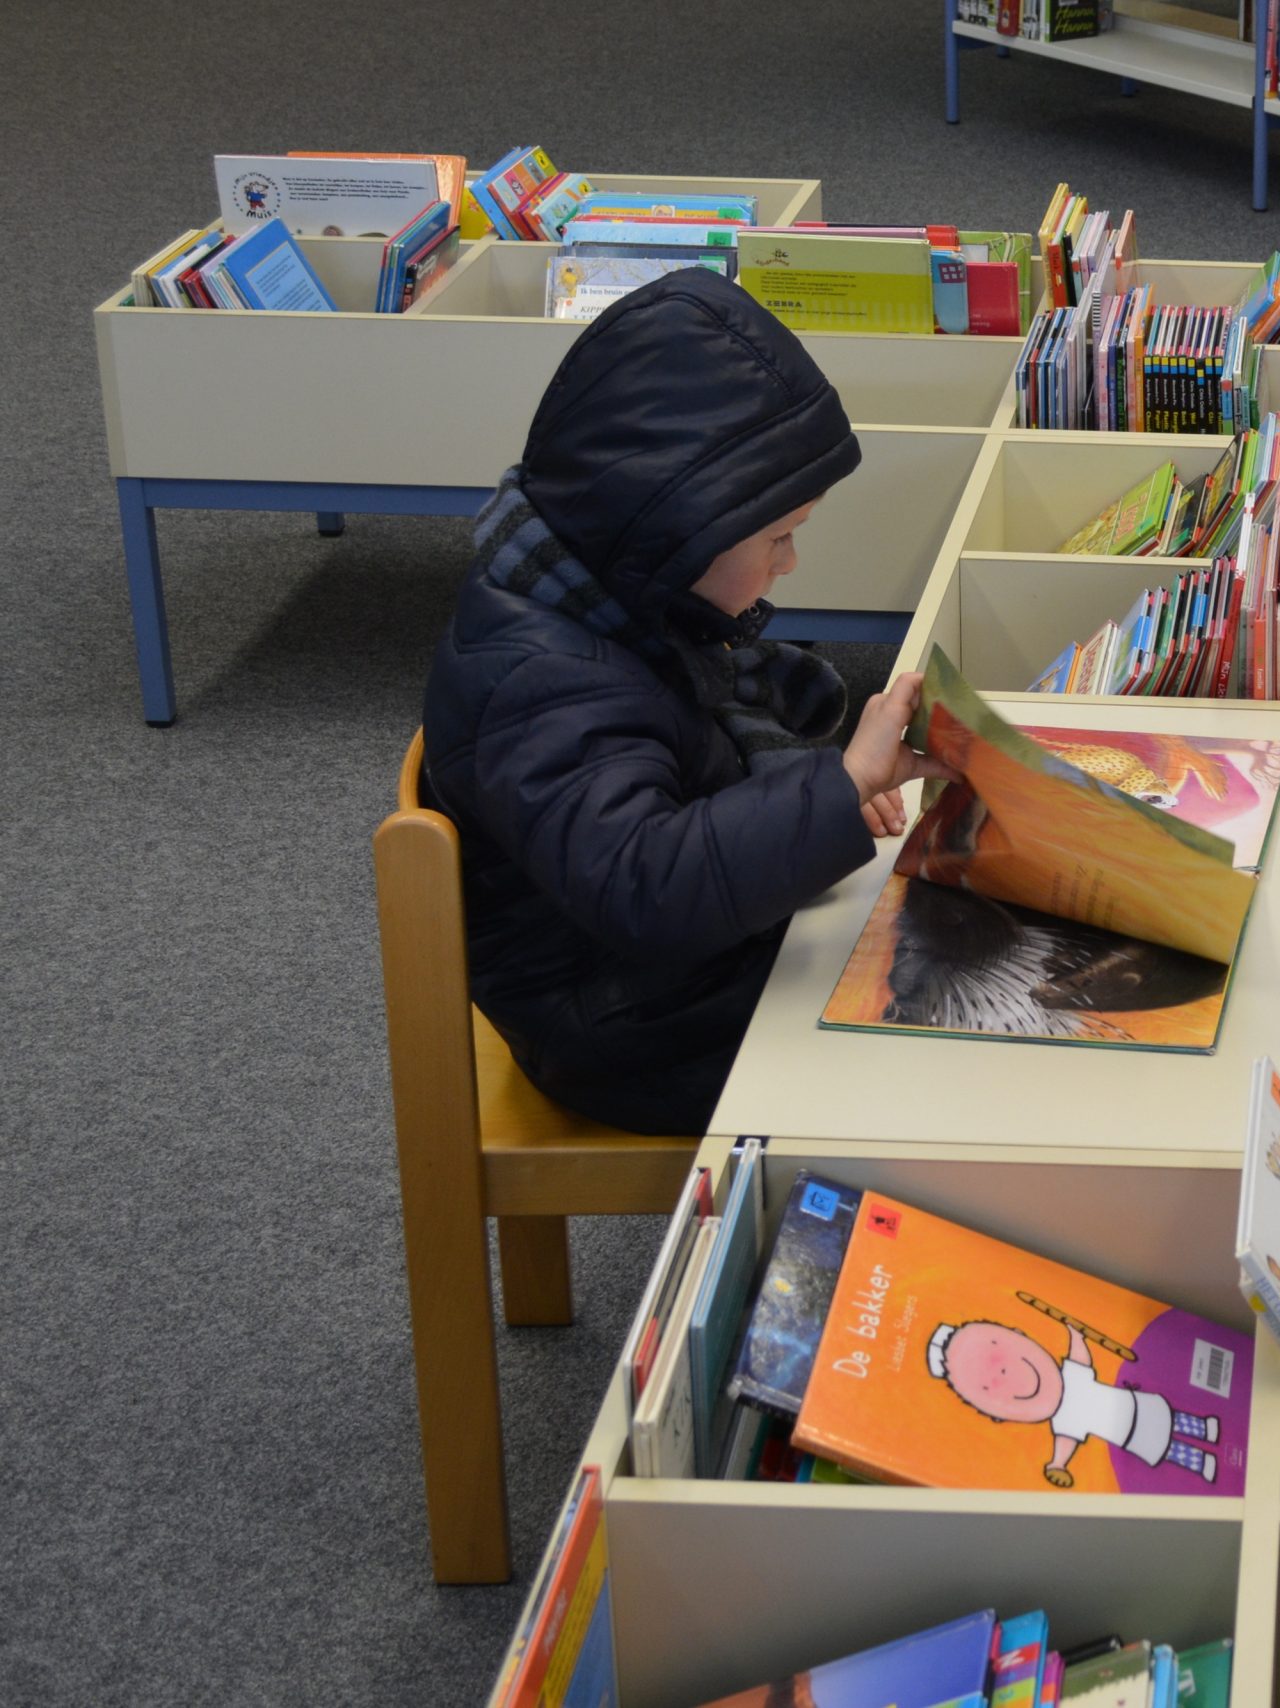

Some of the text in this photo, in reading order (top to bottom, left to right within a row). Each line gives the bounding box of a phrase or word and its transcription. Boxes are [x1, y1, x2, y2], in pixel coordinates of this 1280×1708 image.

[766, 300, 803, 308] ZEBRA
[832, 1264, 892, 1378] De bakker
